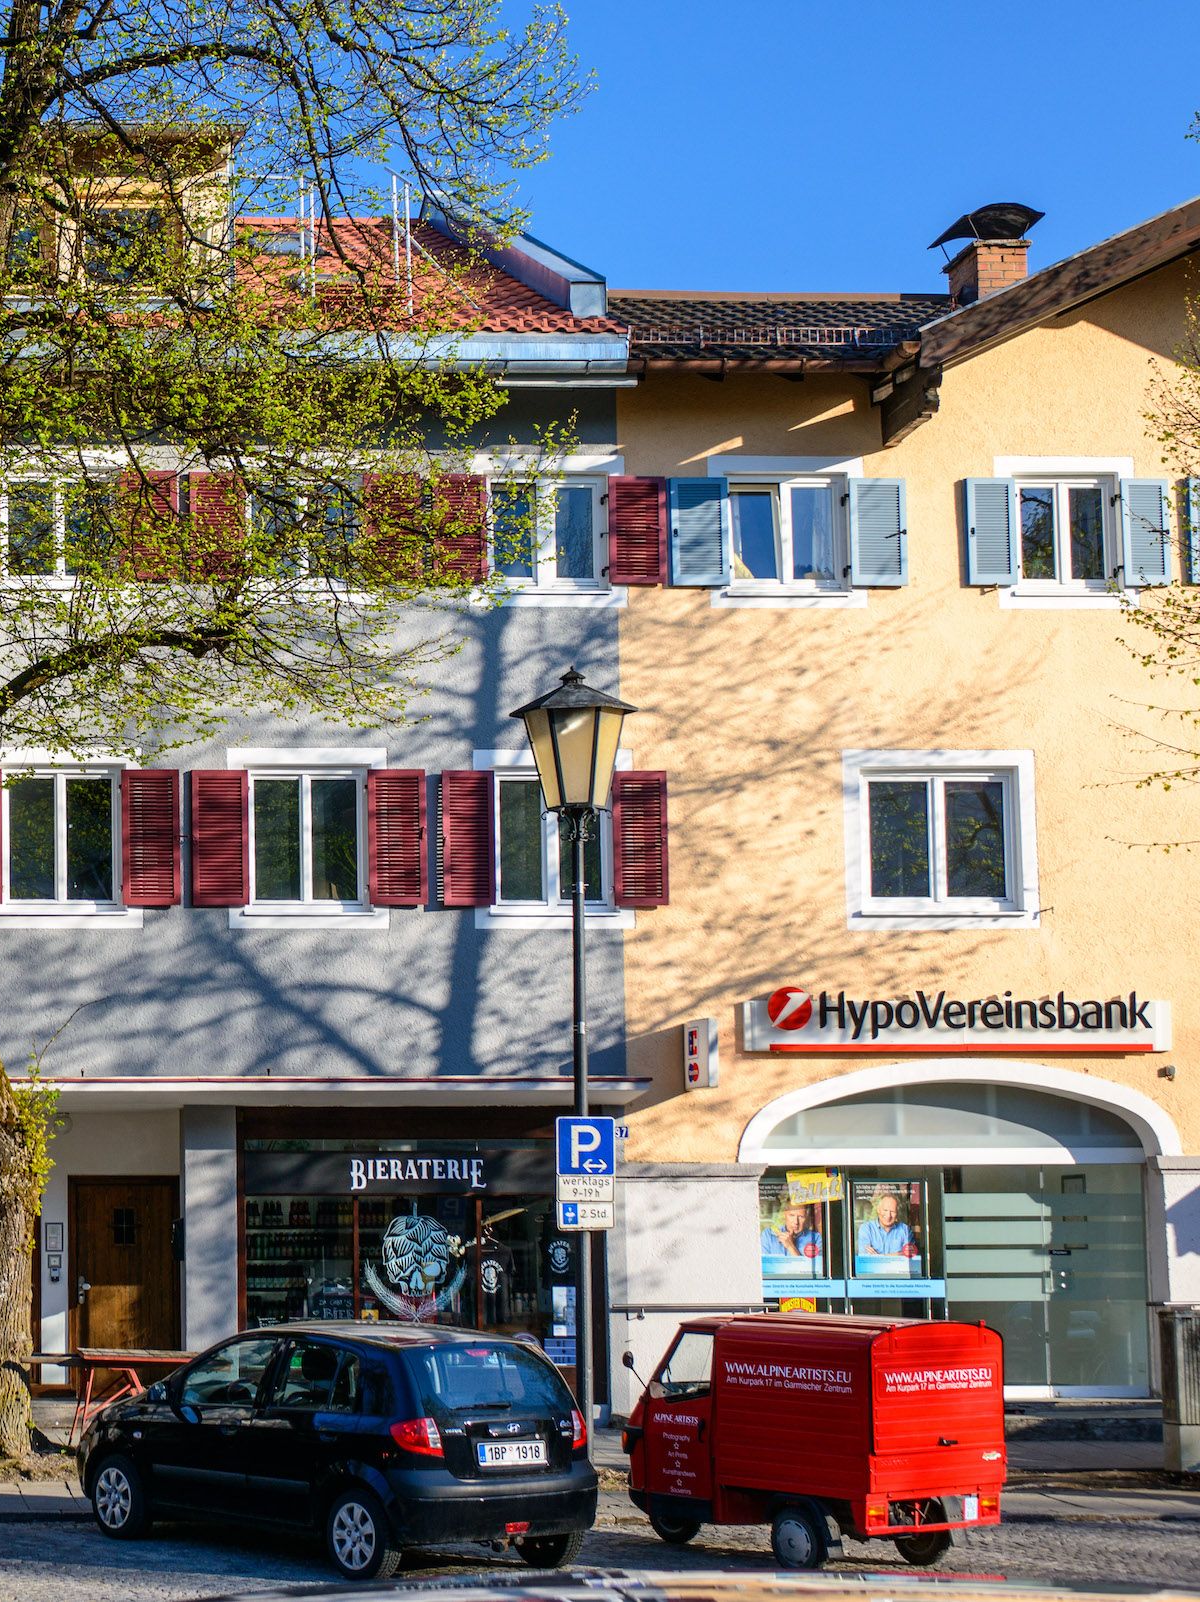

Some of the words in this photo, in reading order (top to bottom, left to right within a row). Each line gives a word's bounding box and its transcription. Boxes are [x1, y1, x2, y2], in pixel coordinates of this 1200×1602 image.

[819, 990, 1153, 1040] HypoVereinsbank
[570, 1124, 602, 1169] P
[350, 1158, 487, 1191] BIERATERIE
[562, 1176, 610, 1189] werktags
[580, 1209, 588, 1219] 2
[590, 1209, 609, 1219] Std.
[725, 1361, 852, 1384] WWW.ALPINEARTISTS.EU
[884, 1367, 993, 1385] WWW.ALPINEARTISTS.EU
[726, 1375, 738, 1384] Am
[739, 1376, 764, 1387] Kurpark
[765, 1378, 773, 1386] 17
[774, 1379, 783, 1387] im
[783, 1380, 822, 1392] Garmischer
[823, 1383, 853, 1394] Zentrum
[886, 1385, 897, 1393] Am
[897, 1383, 920, 1393] Kurpark
[920, 1382, 927, 1390] 17
[928, 1382, 935, 1390] im
[936, 1381, 968, 1390] Garmischer
[969, 1380, 993, 1389] Zentrum
[654, 1413, 673, 1422] ALPINE
[675, 1414, 699, 1425] ARTISTS
[662, 1431, 691, 1442] Photography
[488, 1446, 507, 1461] 1BP
[515, 1445, 540, 1460] 1918
[674, 1451, 688, 1459] Prints
[662, 1468, 696, 1478] Kunsthandwerk
[670, 1486, 692, 1495] Souvenirs
